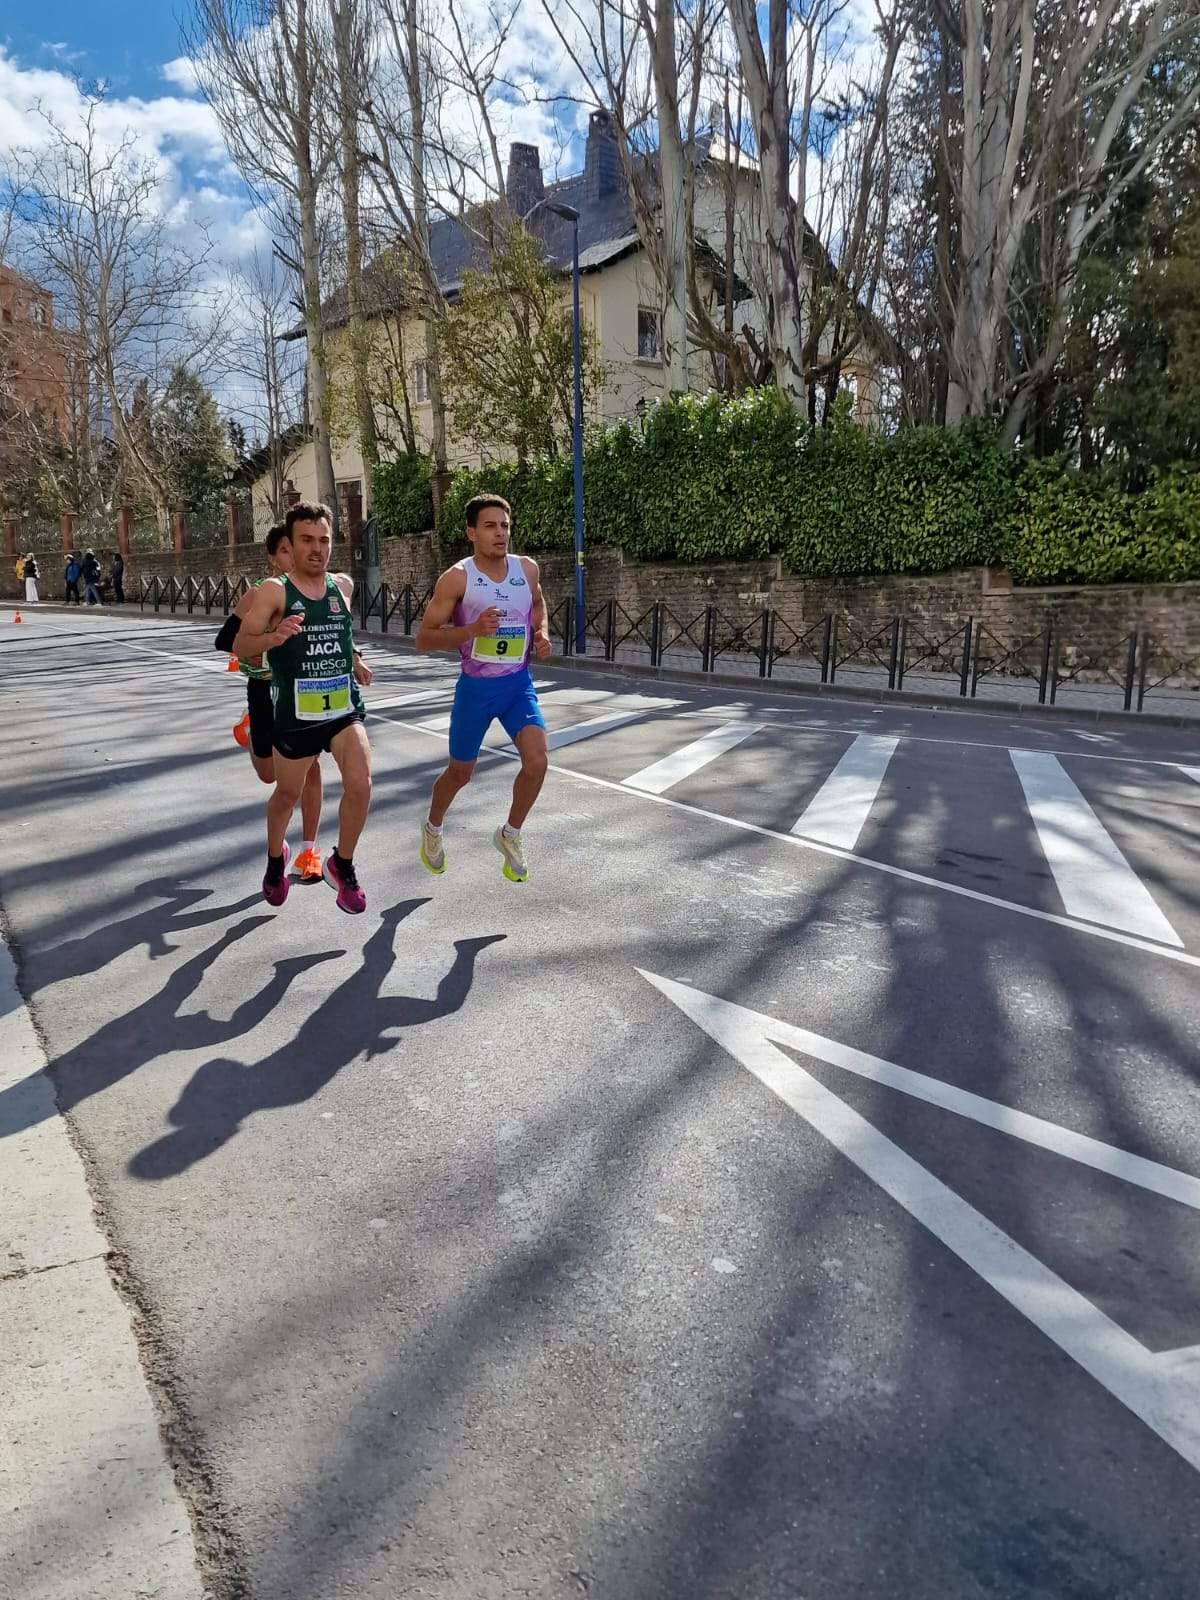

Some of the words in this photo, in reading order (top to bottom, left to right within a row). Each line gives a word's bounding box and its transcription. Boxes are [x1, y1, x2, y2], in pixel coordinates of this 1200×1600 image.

[306, 642, 341, 656] JACA
[496, 641, 508, 654] 9
[302, 658, 346, 671] Huesca
[323, 695, 331, 710] 1
